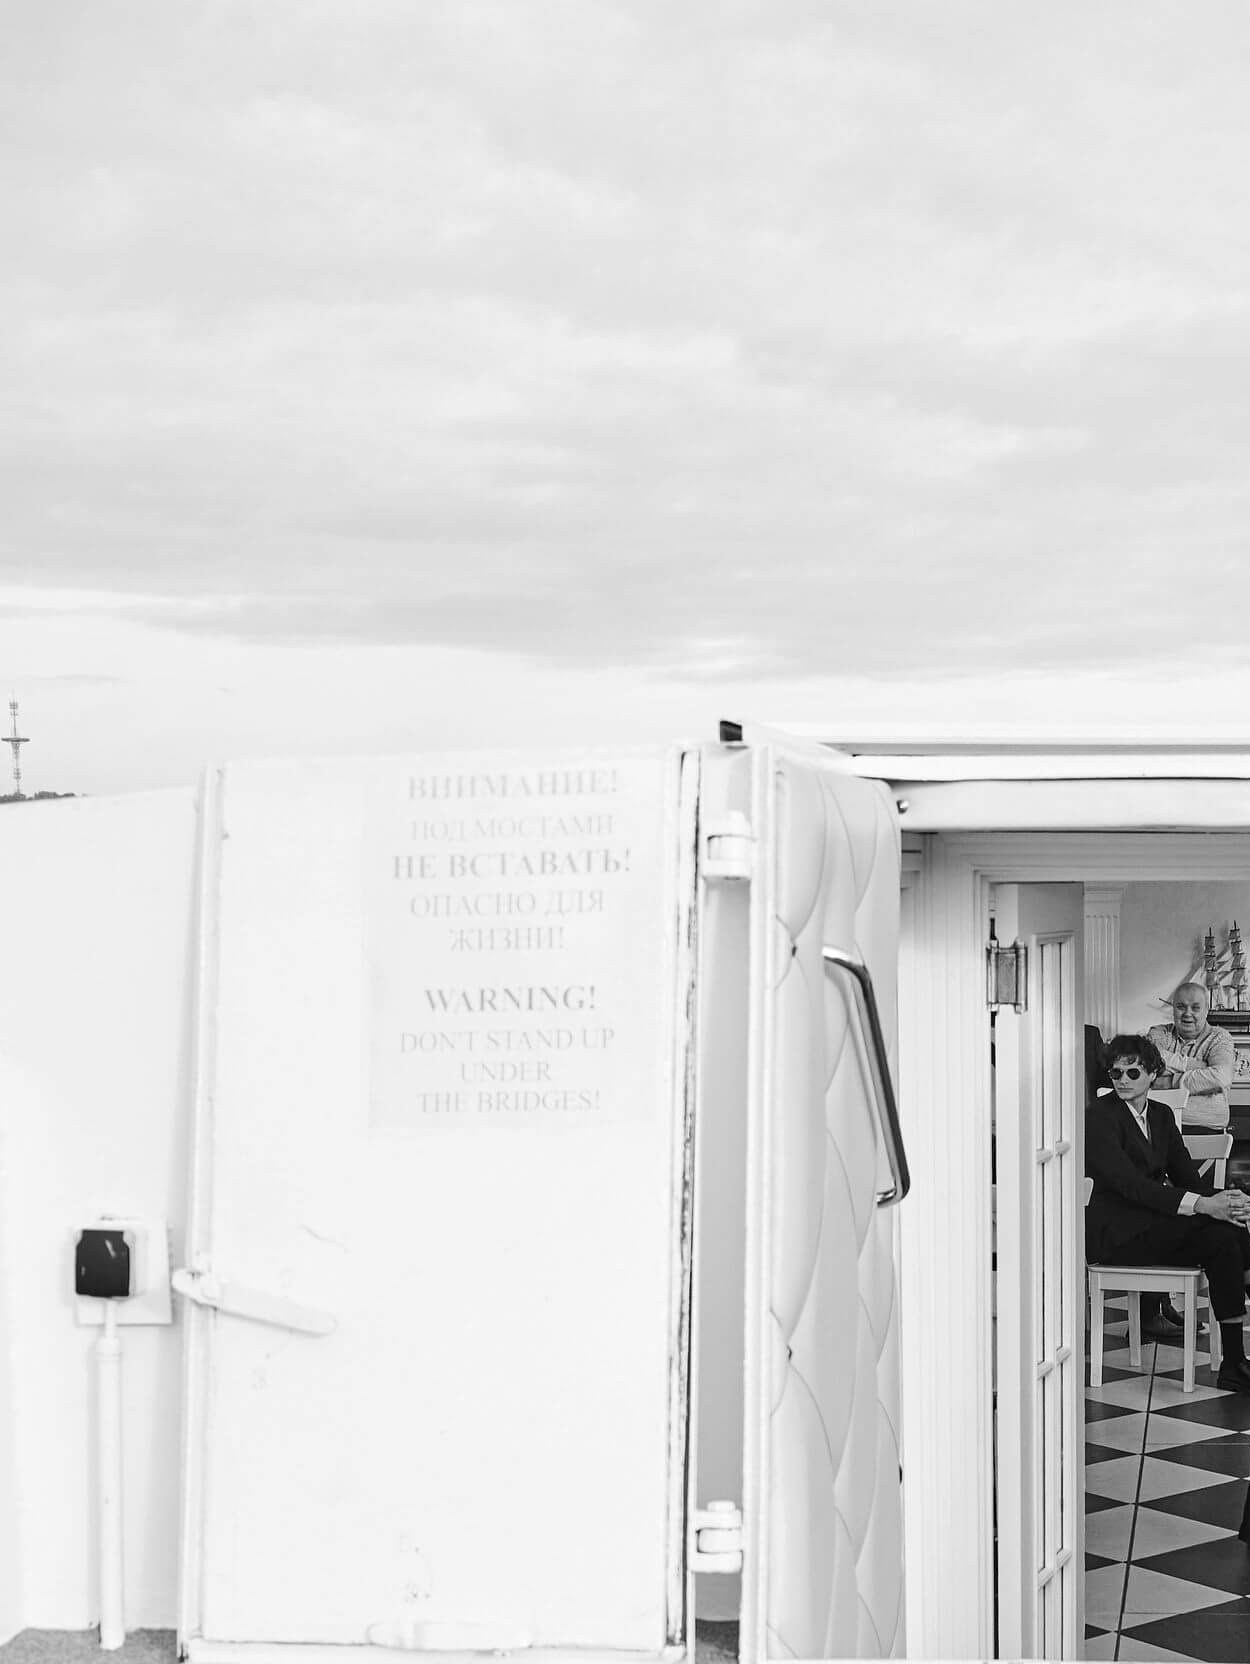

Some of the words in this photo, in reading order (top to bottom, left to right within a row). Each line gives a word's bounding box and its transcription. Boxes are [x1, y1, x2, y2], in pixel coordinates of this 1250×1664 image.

[408, 768, 618, 800] ВНИМАНИЕ!
[392, 854, 437, 880] НЕ
[449, 848, 632, 879] ВСТАВАТЬ!
[409, 892, 537, 918] ОПАСНО
[544, 889, 605, 916] ДЛЯ
[449, 926, 566, 952] ЖИЗНИ!
[424, 985, 597, 1013] WARNING!
[400, 1031, 479, 1053] DON'T
[487, 1028, 574, 1051] STAND
[581, 1027, 616, 1050] UP
[460, 1060, 552, 1082] UNDER
[416, 1090, 467, 1113] THE
[477, 1088, 601, 1113] BRIDGES!
